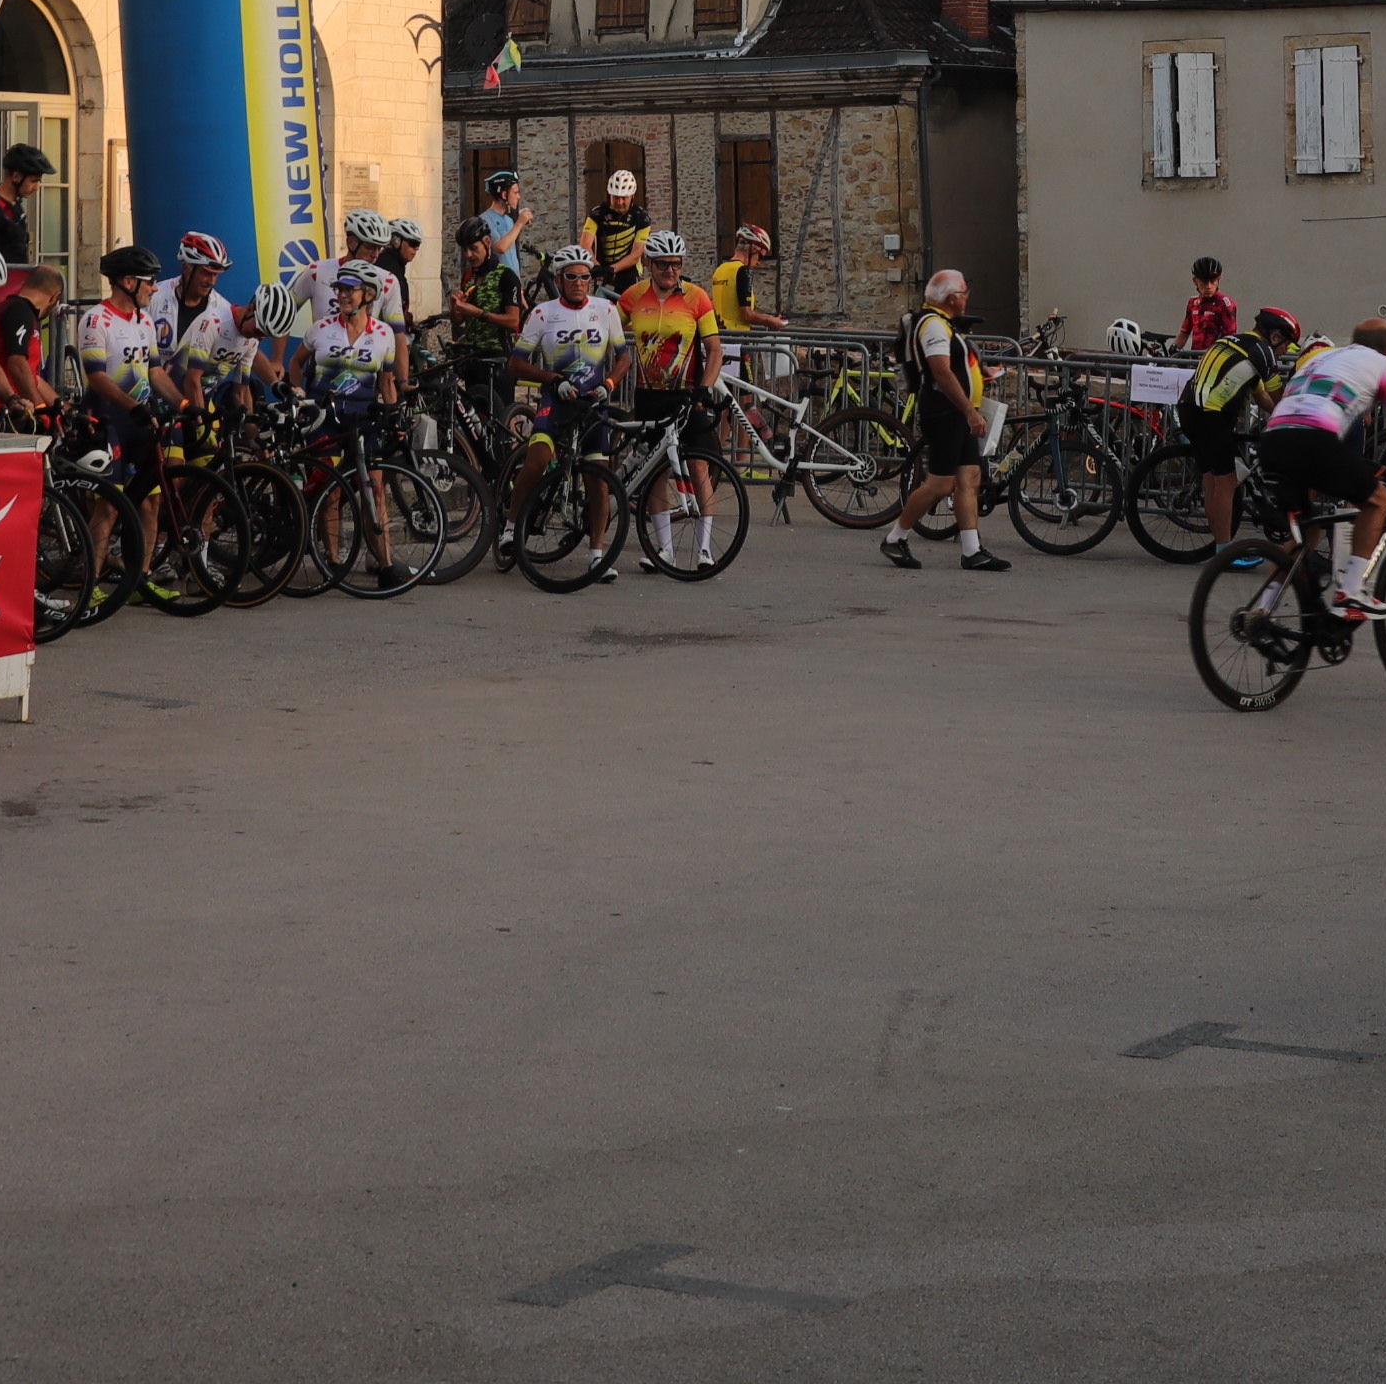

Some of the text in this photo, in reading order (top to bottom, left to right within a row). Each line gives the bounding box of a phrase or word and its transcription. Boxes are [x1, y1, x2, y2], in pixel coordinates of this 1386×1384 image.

[283, 119, 314, 225] NEW
[52, 477, 100, 491] oval
[1238, 693, 1277, 707] DT SWISS
